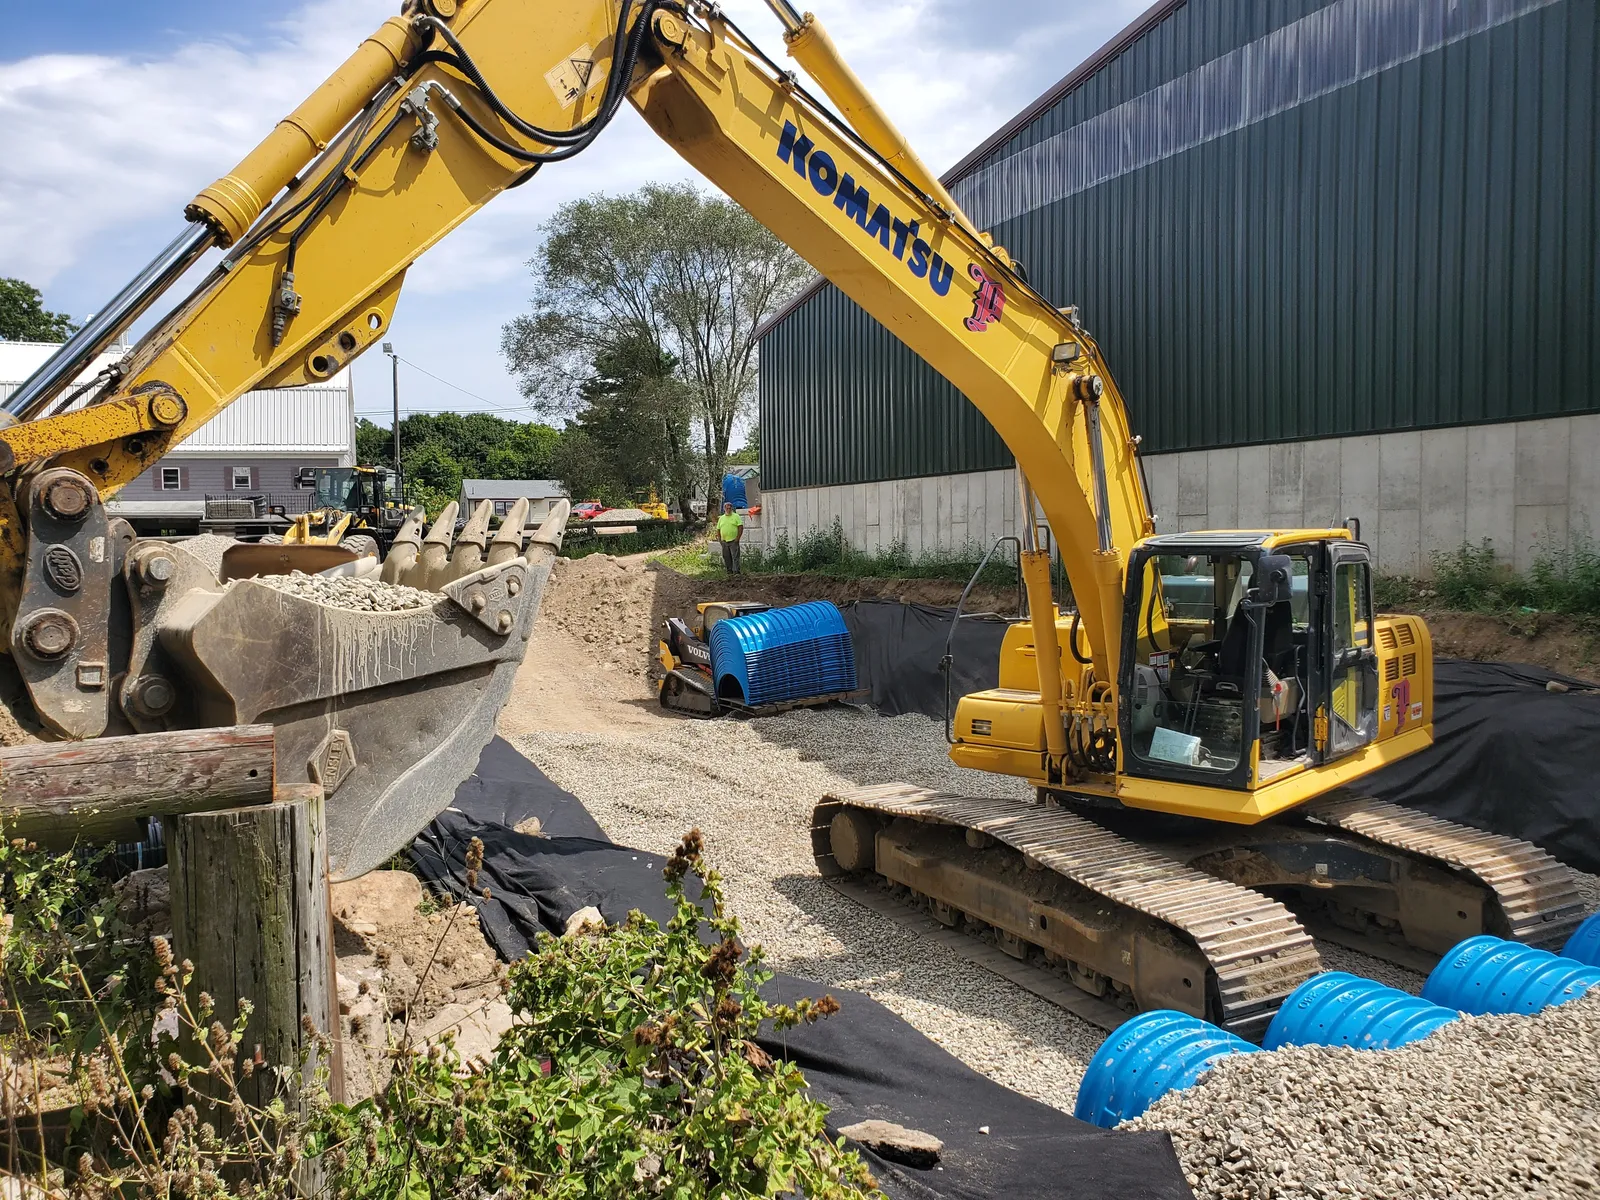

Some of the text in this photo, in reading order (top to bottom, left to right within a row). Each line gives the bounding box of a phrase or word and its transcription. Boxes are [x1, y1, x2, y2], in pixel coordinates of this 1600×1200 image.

[776, 119, 954, 297] KOMATSU
[687, 645, 711, 661] VOLV
[323, 735, 345, 792] HENSLEY
